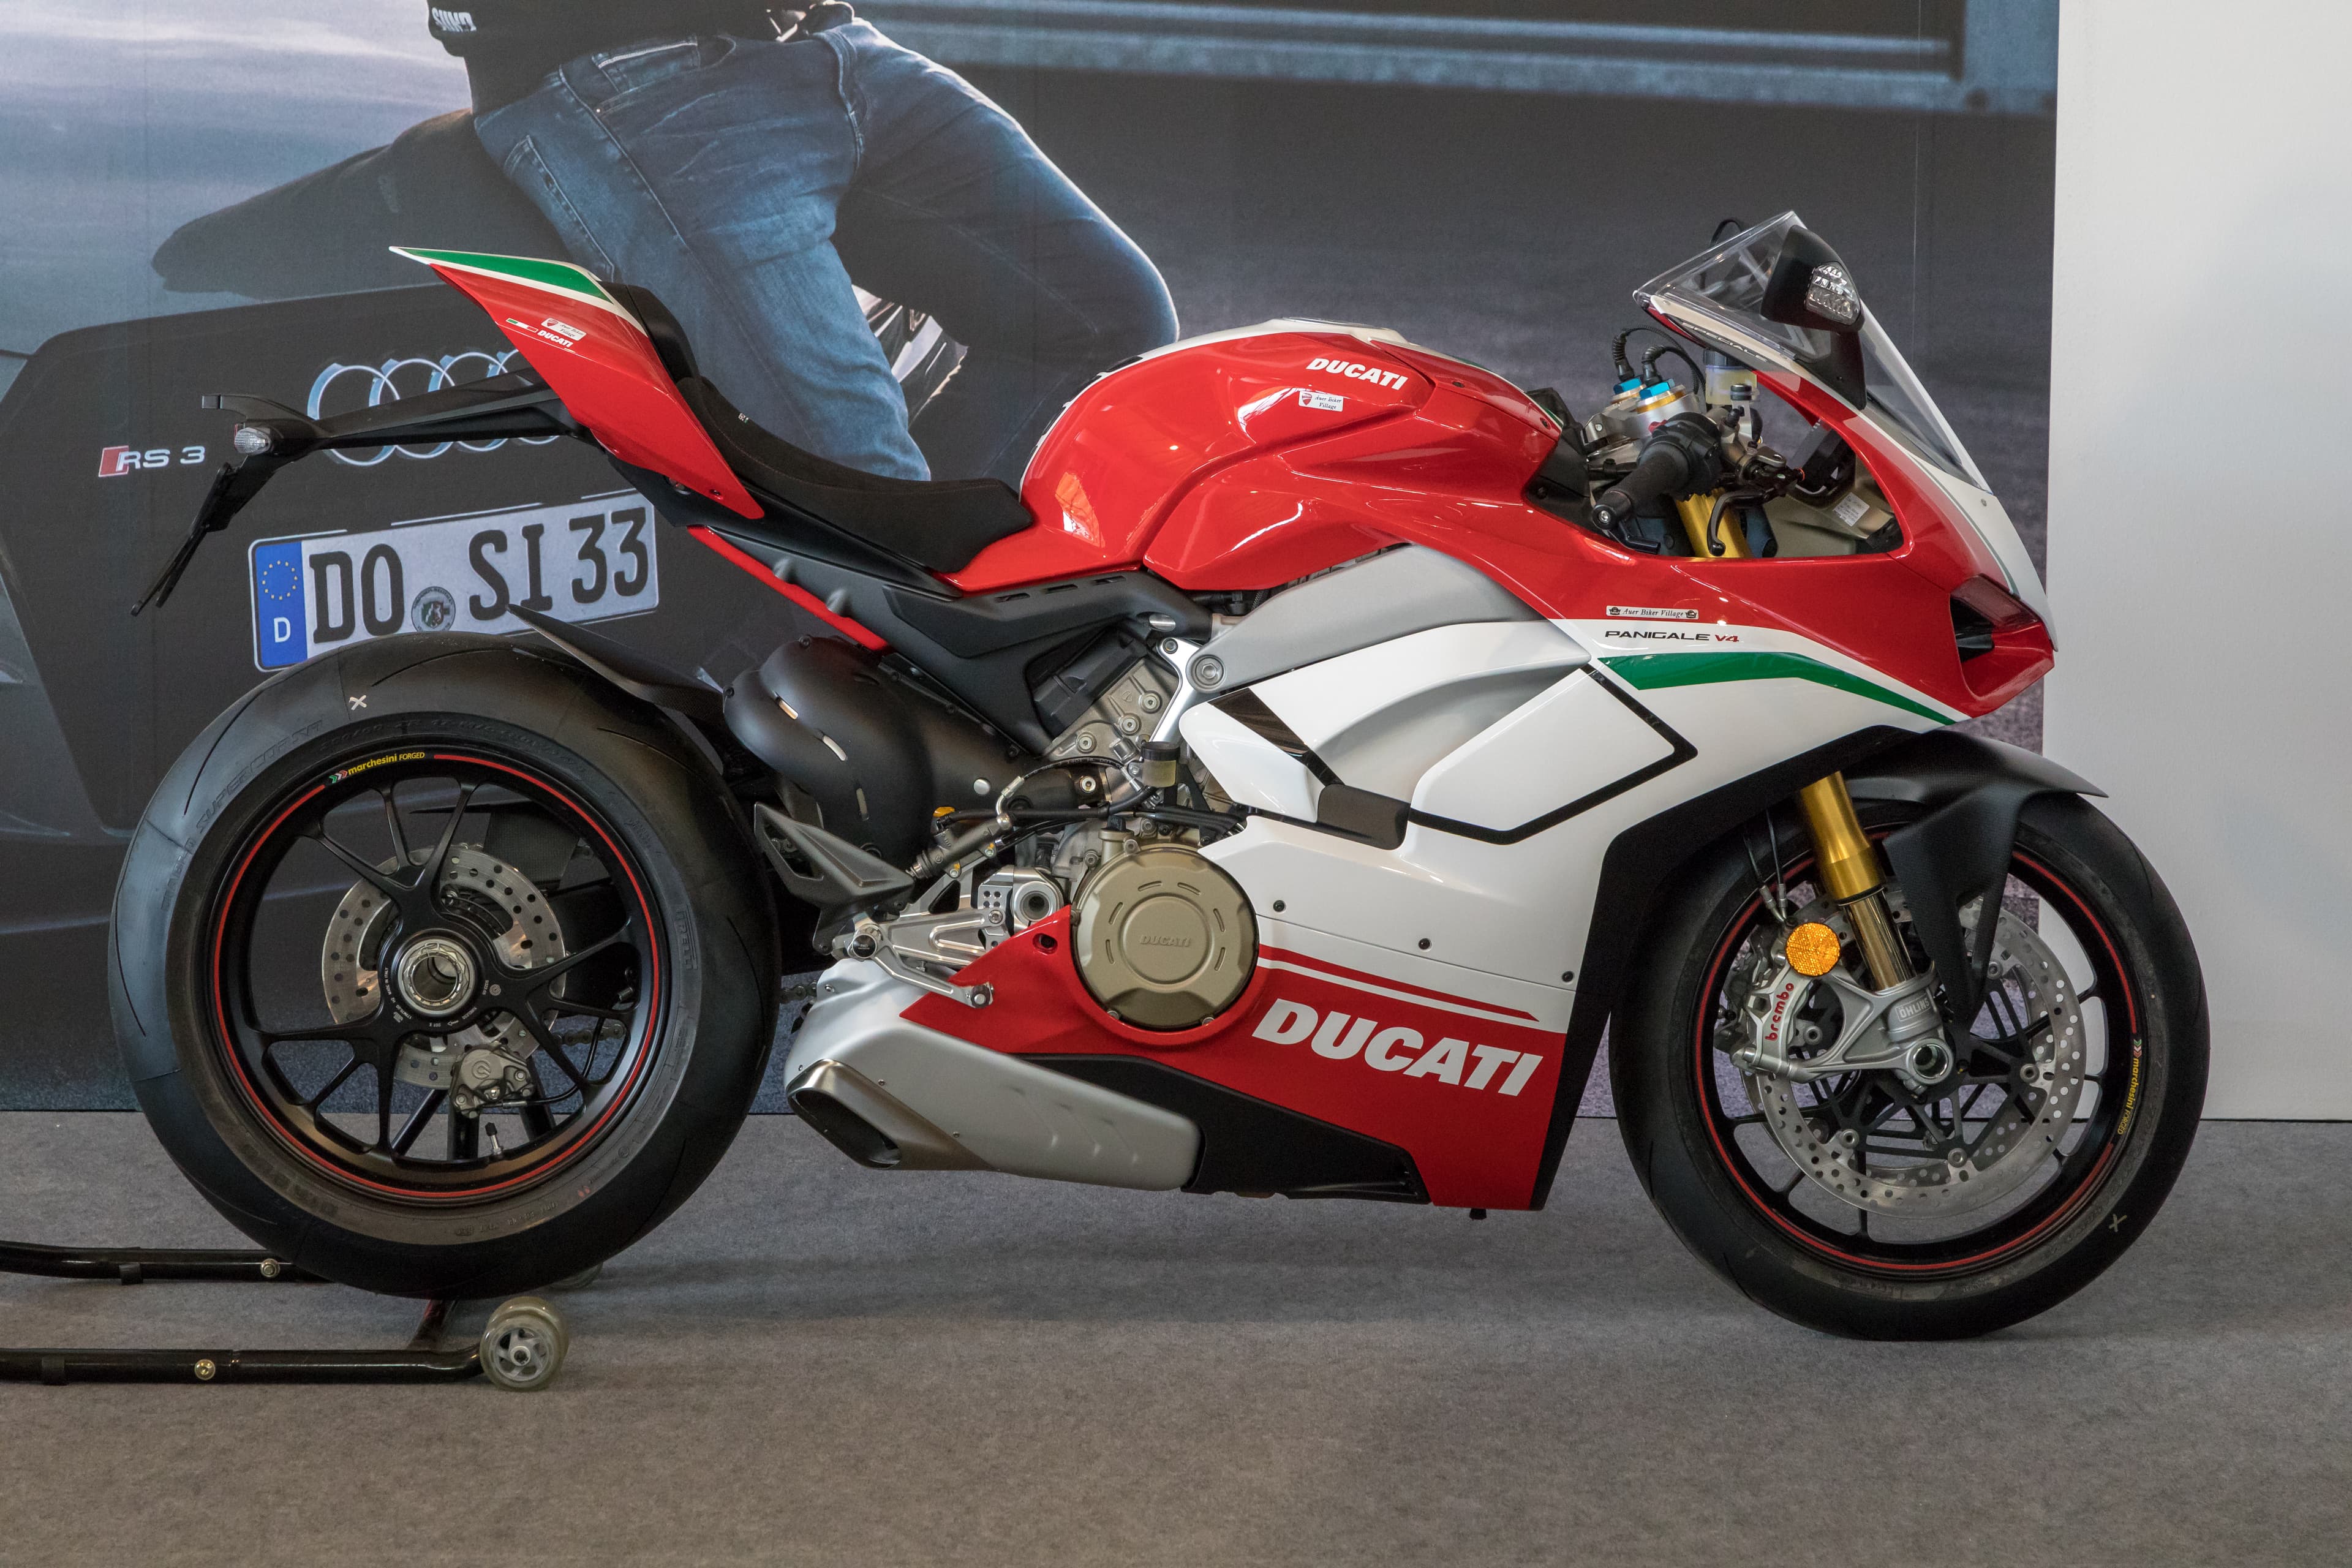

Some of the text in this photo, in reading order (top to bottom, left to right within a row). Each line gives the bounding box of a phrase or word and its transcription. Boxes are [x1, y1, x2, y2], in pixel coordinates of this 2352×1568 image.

[537, 330, 573, 348] DUCATI
[1306, 358, 1409, 390] DUCATI
[115, 446, 206, 472] RS 3
[309, 543, 404, 644] DO
[1660, 609, 1684, 618] Village
[274, 617, 290, 643] D
[1605, 631, 1740, 643] PANIGALE V4
[347, 752, 426, 775] marchesini FORGED
[1139, 935, 1191, 948] DUCATI
[1765, 982, 1795, 1041] brembo
[1899, 997, 1931, 1018] ÖHLINS
[1251, 998, 1544, 1096] DUCATI
[2117, 1058, 2140, 1136] marchesini FORGED
